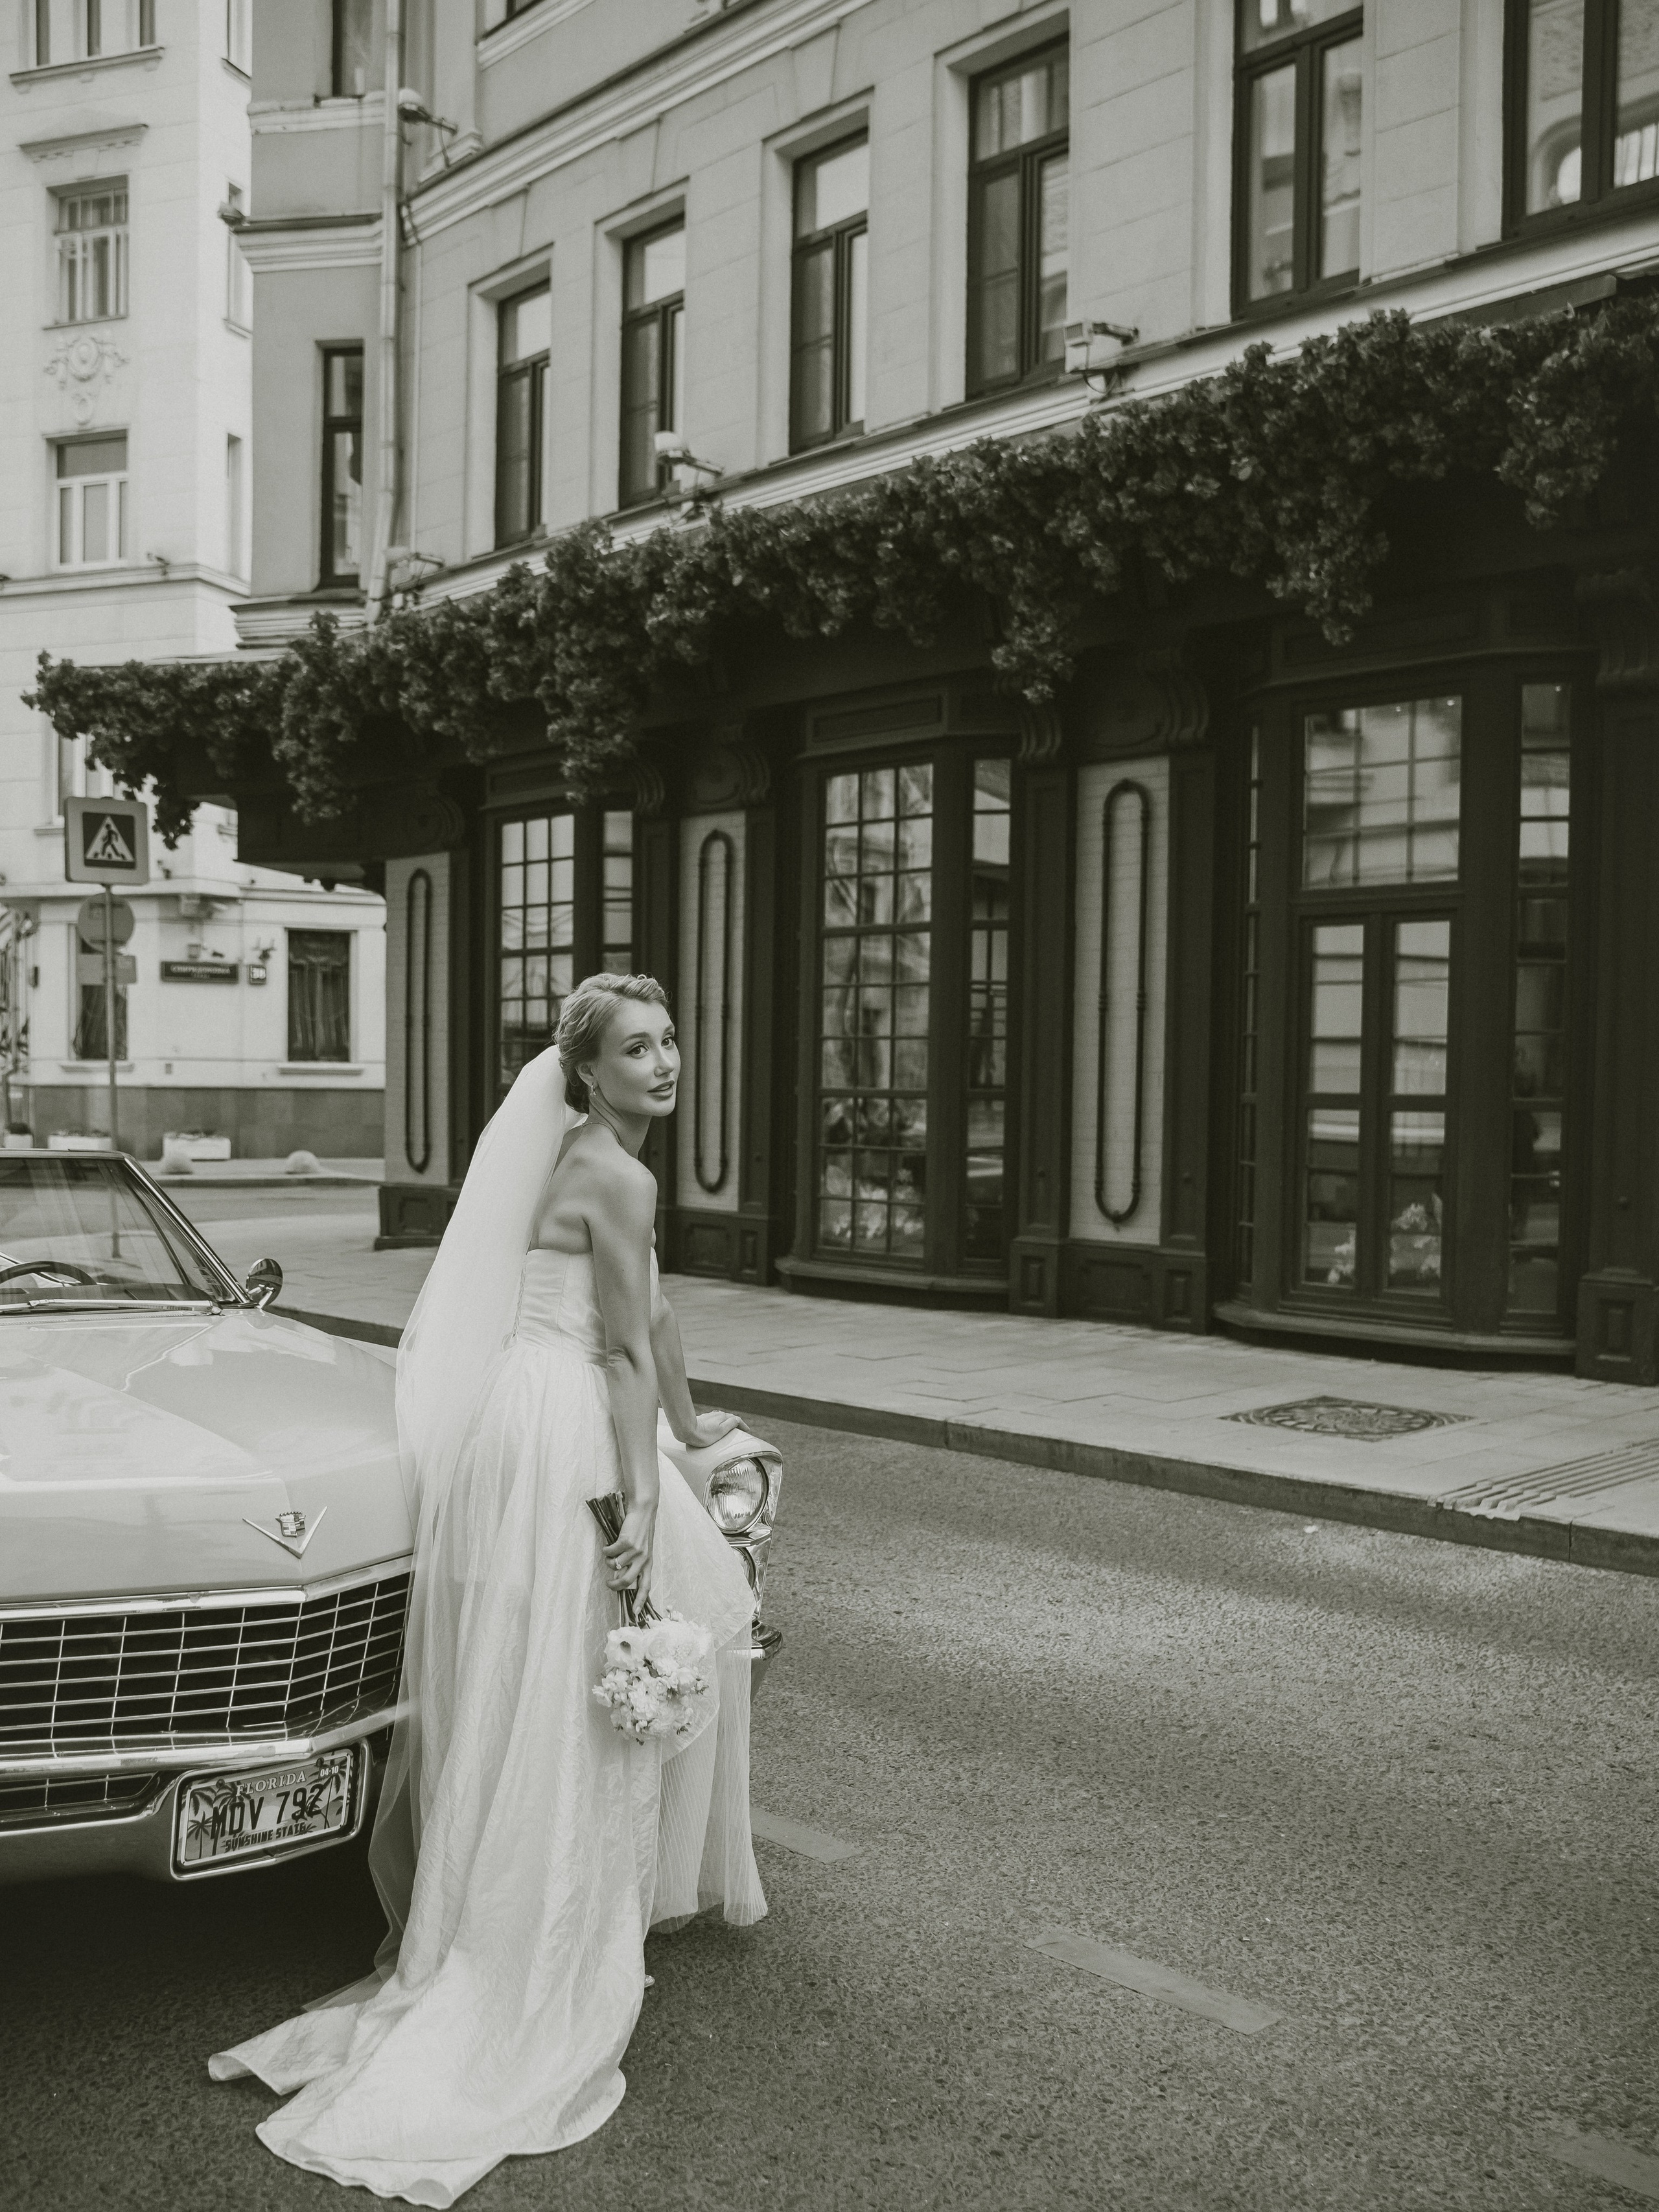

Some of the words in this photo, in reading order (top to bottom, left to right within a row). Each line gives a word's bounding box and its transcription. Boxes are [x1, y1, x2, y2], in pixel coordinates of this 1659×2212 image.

[236, 1771, 306, 1797] FLORIDA
[320, 1765, 339, 1777] 04-10
[211, 1796, 264, 1839] MDV
[276, 1783, 324, 1824] 792
[224, 1829, 273, 1852] SUNSHINE
[275, 1822, 306, 1839] STATE
